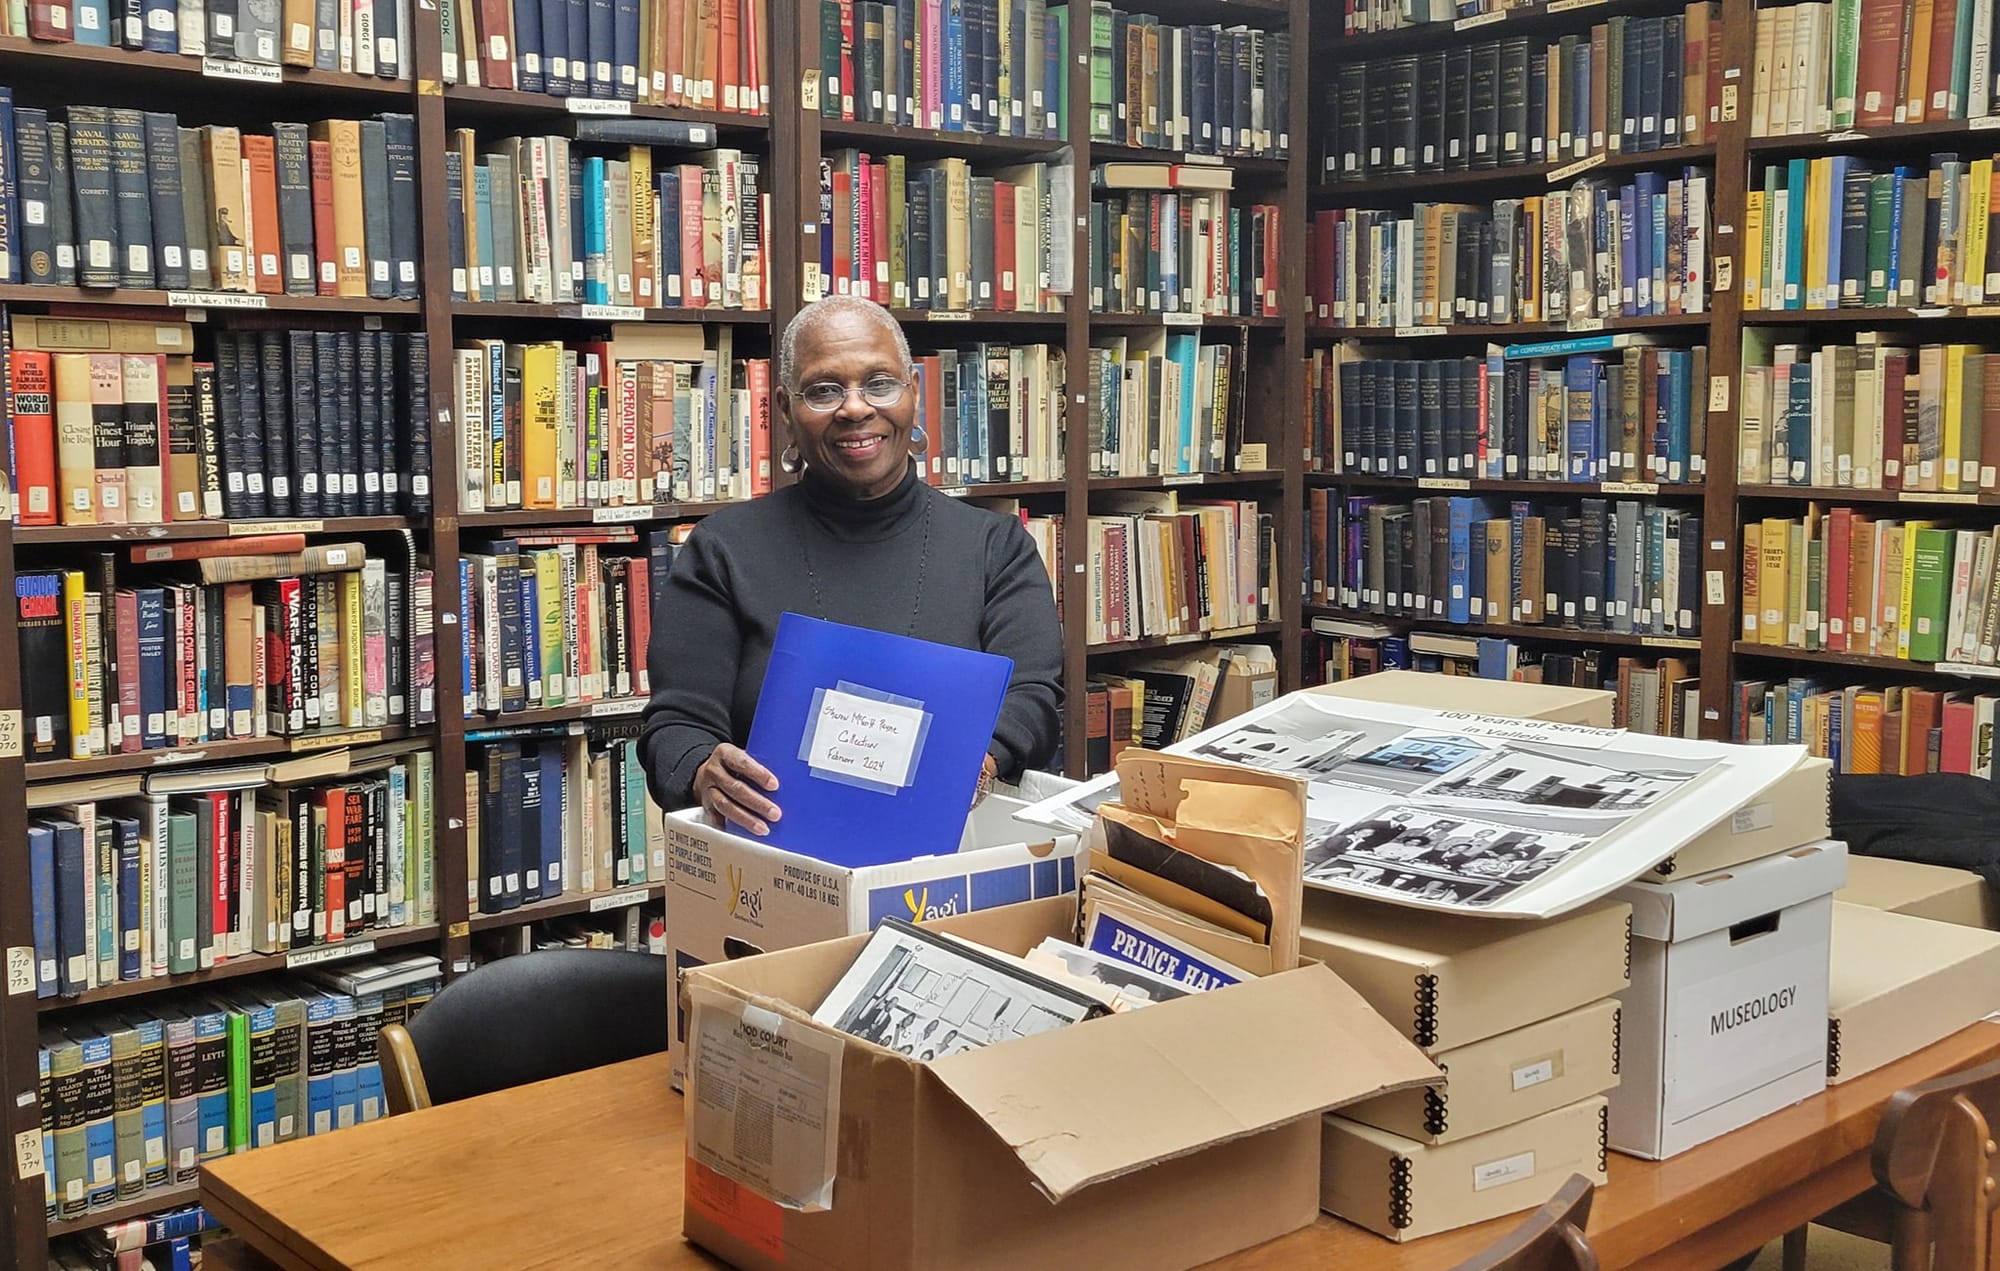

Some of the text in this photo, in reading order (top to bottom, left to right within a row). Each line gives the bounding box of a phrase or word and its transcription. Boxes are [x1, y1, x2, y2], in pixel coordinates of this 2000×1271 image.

[441, 1, 450, 36] BOOK
[1973, 43, 1988, 96] HISTORY
[76, 130, 105, 139] NAVAL
[114, 132, 140, 141] NAVAL
[278, 139, 305, 148] BEATTY
[279, 153, 307, 161] NORTH
[285, 161, 301, 169] SEA
[861, 182, 869, 198] THE
[634, 170, 645, 237] ESCADRILLE
[1941, 179, 1951, 229] VALLEJO
[861, 200, 869, 243] VICTORIAN
[16, 395, 48, 403] WORLD
[17, 403, 49, 414] WAR II
[492, 394, 504, 440] DUNKIRK
[623, 380, 635, 444] OPERATION
[62, 425, 91, 435] Closing
[94, 425, 123, 436] Finest
[123, 421, 156, 432] Triumph
[201, 377, 220, 491] TO HELL AND BACK
[62, 435, 75, 444] the
[96, 436, 121, 447] Hour
[123, 435, 156, 446] Tragedy
[473, 421, 481, 470] CITIZEN
[1514, 515, 1523, 585] THE SPANISH
[1745, 544, 1757, 597] AMERICAN
[15, 574, 62, 598] GUADAL-
[328, 581, 336, 607] DAY
[20, 597, 59, 618] CANAL
[317, 582, 326, 633] INFAMY
[415, 586, 433, 637] IWO JIMA
[490, 585, 499, 649] DESCENT INTO
[568, 557, 580, 679] MacArthur's Jungle War
[616, 583, 624, 653] THE FORGOTTEN
[17, 620, 42, 628] RICHARD
[72, 601, 83, 661] OKINAWA 1945
[183, 604, 196, 714] STORM OVER THE GILBERT
[288, 588, 303, 710] WAR PACIFIC
[255, 637, 264, 690] KAMIKAZE
[309, 633, 318, 701] GHOST COR
[1436, 710, 1618, 738] 100 Years of Service
[1461, 725, 1550, 742] in Vallejo
[863, 756, 885, 772] 2024
[347, 795, 361, 805] SEA
[345, 813, 363, 825] FARE
[423, 810, 431, 829] Navy
[158, 807, 168, 868] SEA BATTLES
[218, 799, 228, 895] The German World War
[675, 832, 709, 853] WHITE SWEETS
[101, 841, 112, 874] FROGMAN
[246, 825, 254, 892] Hunter-Killer
[299, 802, 308, 898] THE DESTRUCTION OF CONVOY
[674, 846, 712, 869] PURPLE SWEETS
[423, 875, 431, 892] Two
[675, 860, 717, 884] JAPANESE SWEETS
[783, 864, 840, 892] PRODUCE OF U.S.A.
[726, 863, 764, 919] Yagi
[773, 877, 840, 907] NET WT. 40 LBS KGS
[10, 959, 29, 968] 770
[1111, 927, 1181, 979] PRINCE
[10, 978, 29, 987] 773
[15, 969, 24, 978] D
[1710, 985, 1797, 1036] MUSEOLOGY
[759, 1030, 789, 1049] COURT
[202, 1050, 226, 1062] LEYTE
[87, 1074, 111, 1083] BATTLE
[86, 1088, 112, 1099] ATLANTIC
[20, 1160, 40, 1170] 774
[24, 1152, 33, 1161] D
